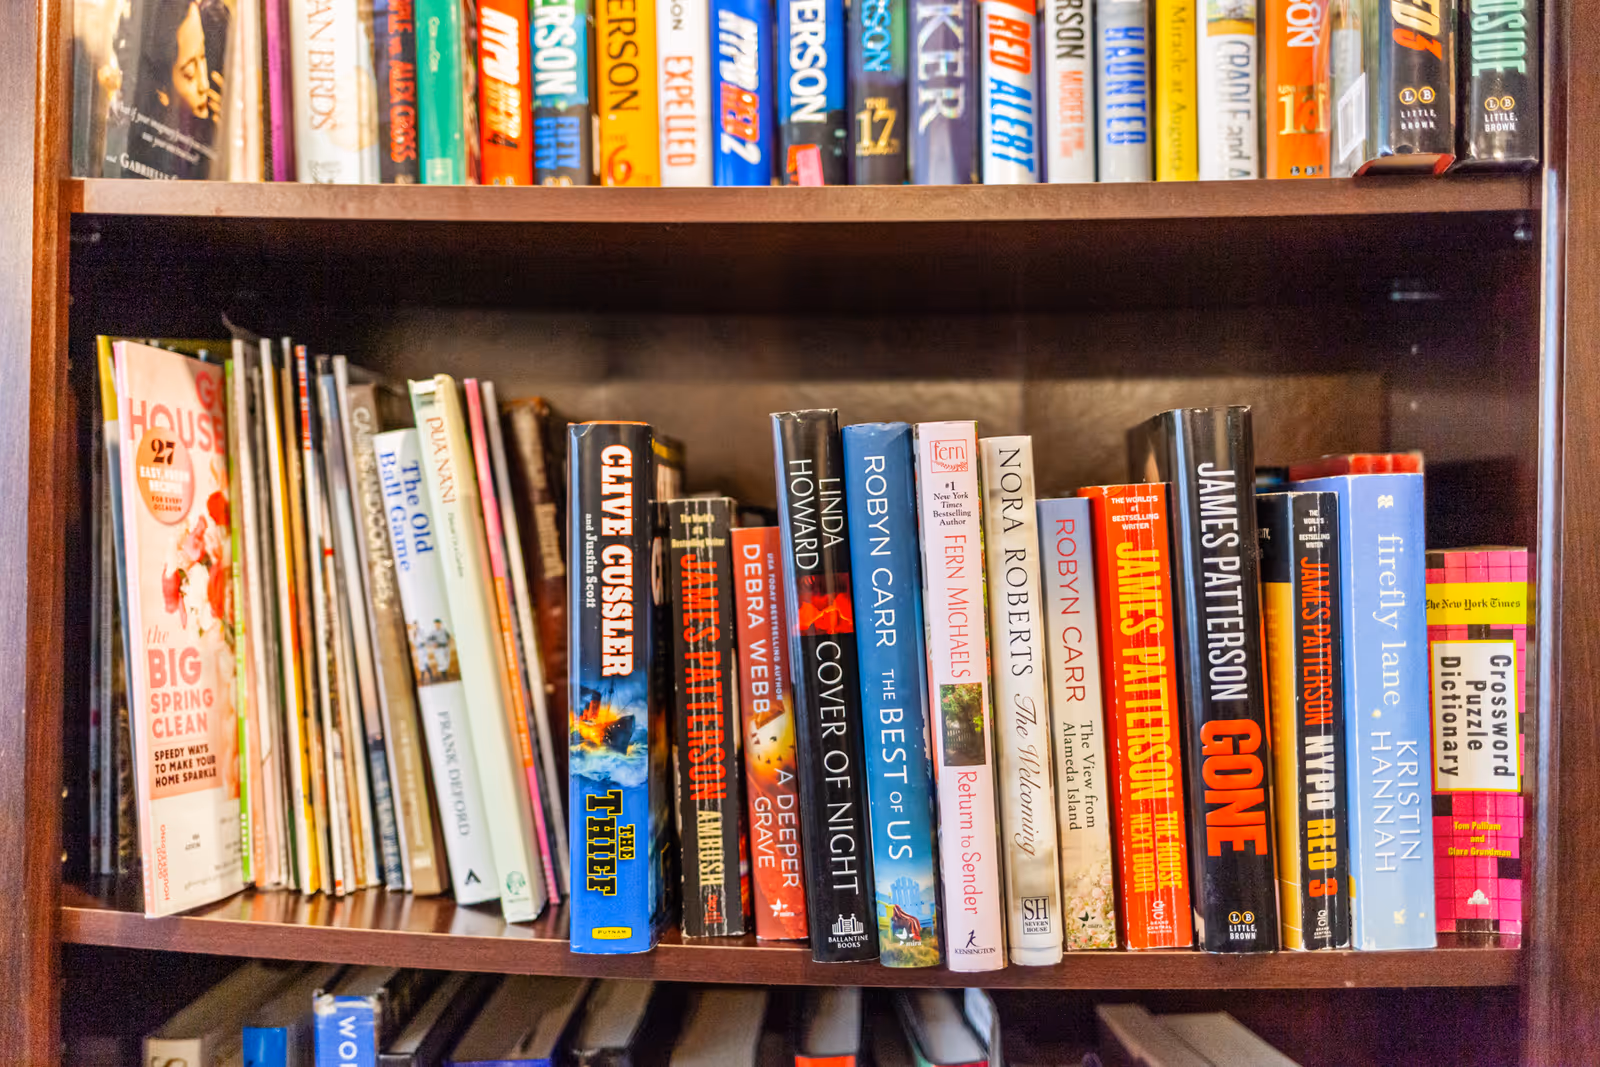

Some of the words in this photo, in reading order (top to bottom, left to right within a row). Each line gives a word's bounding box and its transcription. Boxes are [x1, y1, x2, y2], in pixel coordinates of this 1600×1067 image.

[789, 0, 828, 123] ERSON
[987, 13, 1032, 75] RED
[307, 50, 338, 131] BIRDS
[388, 60, 415, 104] ALEX
[1105, 27, 1147, 145] HAUNTED
[664, 56, 696, 167] EXPELLED
[989, 76, 1035, 173] ALERT
[1401, 121, 1435, 130] BROWN
[1484, 112, 1518, 122] LITTLE,
[1484, 123, 1515, 132] BROWN
[389, 105, 417, 163] CROSS
[151, 438, 176, 465] 27
[933, 440, 966, 461] fern
[379, 451, 403, 498] Ball
[402, 459, 422, 506] The
[601, 444, 634, 537] CLIVE
[933, 492, 952, 501] New
[952, 490, 969, 501] York
[944, 481, 956, 492] #1
[998, 448, 1025, 534] NORA
[789, 459, 820, 571] HOWARD
[818, 477, 845, 549] LINDA
[863, 455, 892, 557] ROBYN
[933, 508, 972, 519] Bestselling
[940, 500, 963, 509] Times
[1111, 496, 1125, 504] THE
[1125, 495, 1158, 504] WORLD'S
[1112, 513, 1160, 522] BESTSELLING
[1130, 504, 1139, 512] #1
[1197, 462, 1240, 549] JAMES
[1308, 509, 1320, 517] THE
[390, 505, 411, 572] Game
[410, 513, 435, 554] Old
[585, 513, 595, 532] and
[671, 538, 705, 549] Bestselling
[939, 517, 966, 527] Author
[1121, 522, 1150, 531] WRITER
[1299, 533, 1331, 541] BESTSELLING
[1308, 525, 1317, 533] #1
[585, 533, 598, 574] Justin
[767, 553, 775, 571] USA
[943, 534, 967, 580] FERN
[1055, 518, 1081, 616] ROBYN
[1305, 541, 1324, 549] WRITER
[585, 576, 598, 609] Scott
[680, 553, 721, 643] JAMES
[742, 544, 765, 629] DEBRA
[768, 572, 778, 603] TODAY
[1115, 541, 1165, 637] JAMES
[1300, 556, 1332, 621] JAMES
[1372, 533, 1406, 631] firefly
[1426, 599, 1441, 610] The
[1442, 599, 1463, 609] New
[1464, 599, 1488, 611] York
[1489, 597, 1521, 609] Times
[601, 544, 634, 677] CUSSLER
[871, 566, 898, 648] CARR
[1004, 547, 1034, 677] ROBERTS
[1203, 556, 1249, 701] PATTERSON
[146, 625, 170, 644] the
[770, 603, 781, 662] BESTSELLING
[946, 587, 971, 679] MICHAELS
[147, 646, 202, 689] BIG
[749, 639, 771, 714] WEBB
[774, 664, 784, 701] AUTHOR
[881, 668, 895, 700] THE
[1062, 626, 1086, 703] CARR
[1302, 624, 1334, 726] PATTERSON
[1381, 641, 1407, 706] lane
[150, 688, 214, 715] SPRING
[815, 640, 848, 739] COVER
[152, 712, 208, 739] CLEAN
[684, 651, 727, 800] PATTERSON
[1013, 693, 1037, 740] The
[1080, 720, 1094, 749] The
[1122, 645, 1175, 802] PATTERSON
[1438, 655, 1463, 777] Dictionary
[1465, 680, 1489, 751] Puzzle
[1489, 654, 1516, 777] Crossword
[154, 746, 185, 762] SPEEDY
[187, 743, 210, 760] WAYS
[155, 764, 167, 774] TO
[169, 758, 194, 773] MAKE
[196, 754, 217, 768] YOUR
[879, 708, 908, 784] BEST
[1063, 721, 1079, 783] Alameda
[155, 773, 180, 788] HOME
[182, 767, 218, 785] SPARKLE
[437, 710, 458, 767] FRANK
[448, 769, 470, 837] DEFORD
[773, 768, 794, 785] A
[823, 749, 851, 789] OF
[1082, 753, 1097, 790] View
[1200, 718, 1268, 857] GONE
[1304, 734, 1336, 811] NYPD
[889, 790, 903, 813] OF
[956, 770, 978, 831] Return
[1014, 744, 1041, 860] Welcoming
[1067, 787, 1083, 831] Island
[1084, 793, 1099, 829] from
[1370, 730, 1397, 873] HANNAH
[1396, 740, 1422, 861] KRISTIN
[586, 789, 623, 896] THIEF
[618, 824, 635, 860] THE
[753, 796, 776, 869] GRAVE
[775, 794, 800, 888] DEEPER
[886, 819, 913, 861] US
[961, 834, 975, 849] to
[1130, 812, 1155, 848] NEXT
[1158, 810, 1180, 838] THE
[1306, 818, 1338, 871] RED
[1453, 821, 1470, 830] Tom
[1470, 834, 1485, 843] and
[698, 810, 725, 886] AMBUSH
[827, 801, 859, 895] NIGHT
[1158, 840, 1182, 890] HOUSE
[1448, 847, 1469, 857] Clare
[960, 851, 983, 915] Sender
[1132, 850, 1157, 893] DOOR
[1308, 877, 1338, 898] 3
[1023, 898, 1049, 922] SH
[1025, 920, 1049, 928] SEVERN
[1229, 924, 1258, 932] LITTLE,
[828, 933, 869, 944] BALLANTINE
[837, 940, 861, 949] BOOKS
[954, 946, 996, 955] KENSINGTON
[1229, 931, 1256, 940] BROWN
